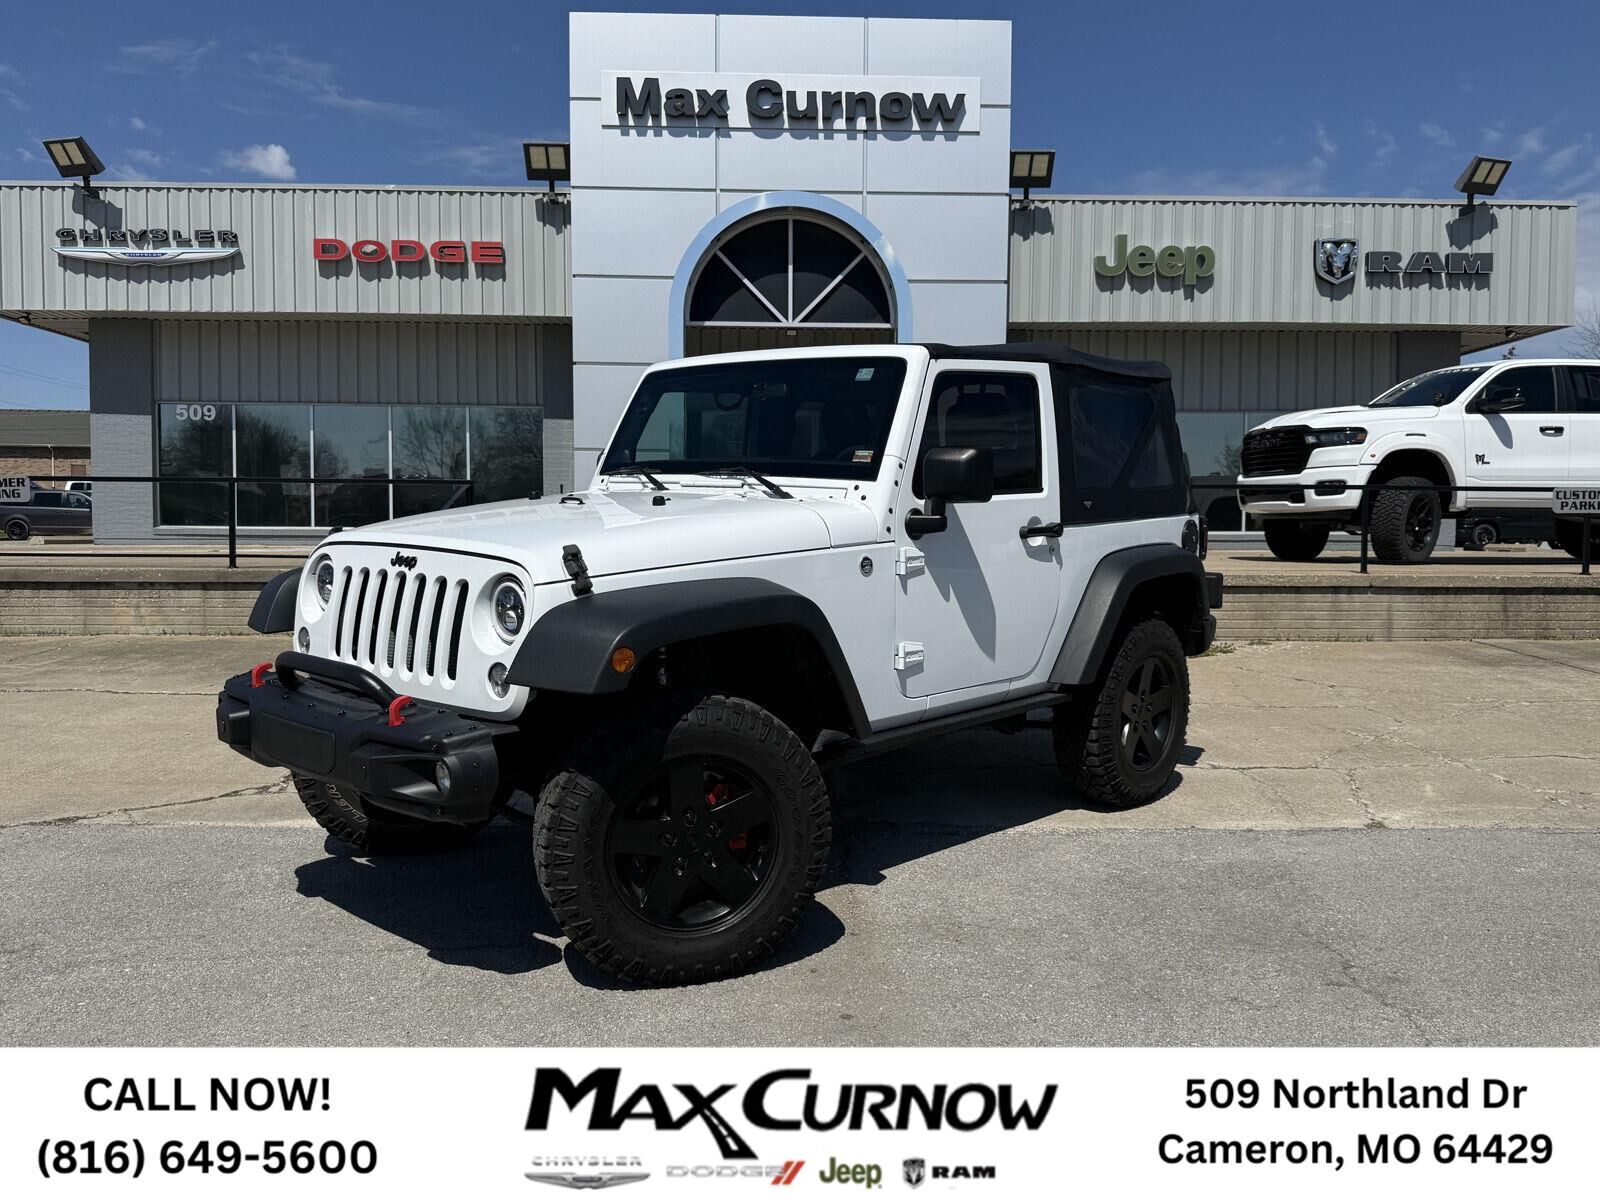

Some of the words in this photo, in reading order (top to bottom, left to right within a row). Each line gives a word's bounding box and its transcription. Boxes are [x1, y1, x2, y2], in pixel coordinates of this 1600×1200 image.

[616, 77, 729, 119] Max
[745, 79, 966, 122] Curnow
[55, 227, 237, 242] CHRYSLER
[313, 238, 504, 263] DODGE
[1093, 234, 1215, 285] Jeep
[1365, 251, 1493, 274] RAM
[175, 404, 216, 421] 509
[1556, 490, 1600, 500] CUSTO
[390, 551, 418, 571] Jeep
